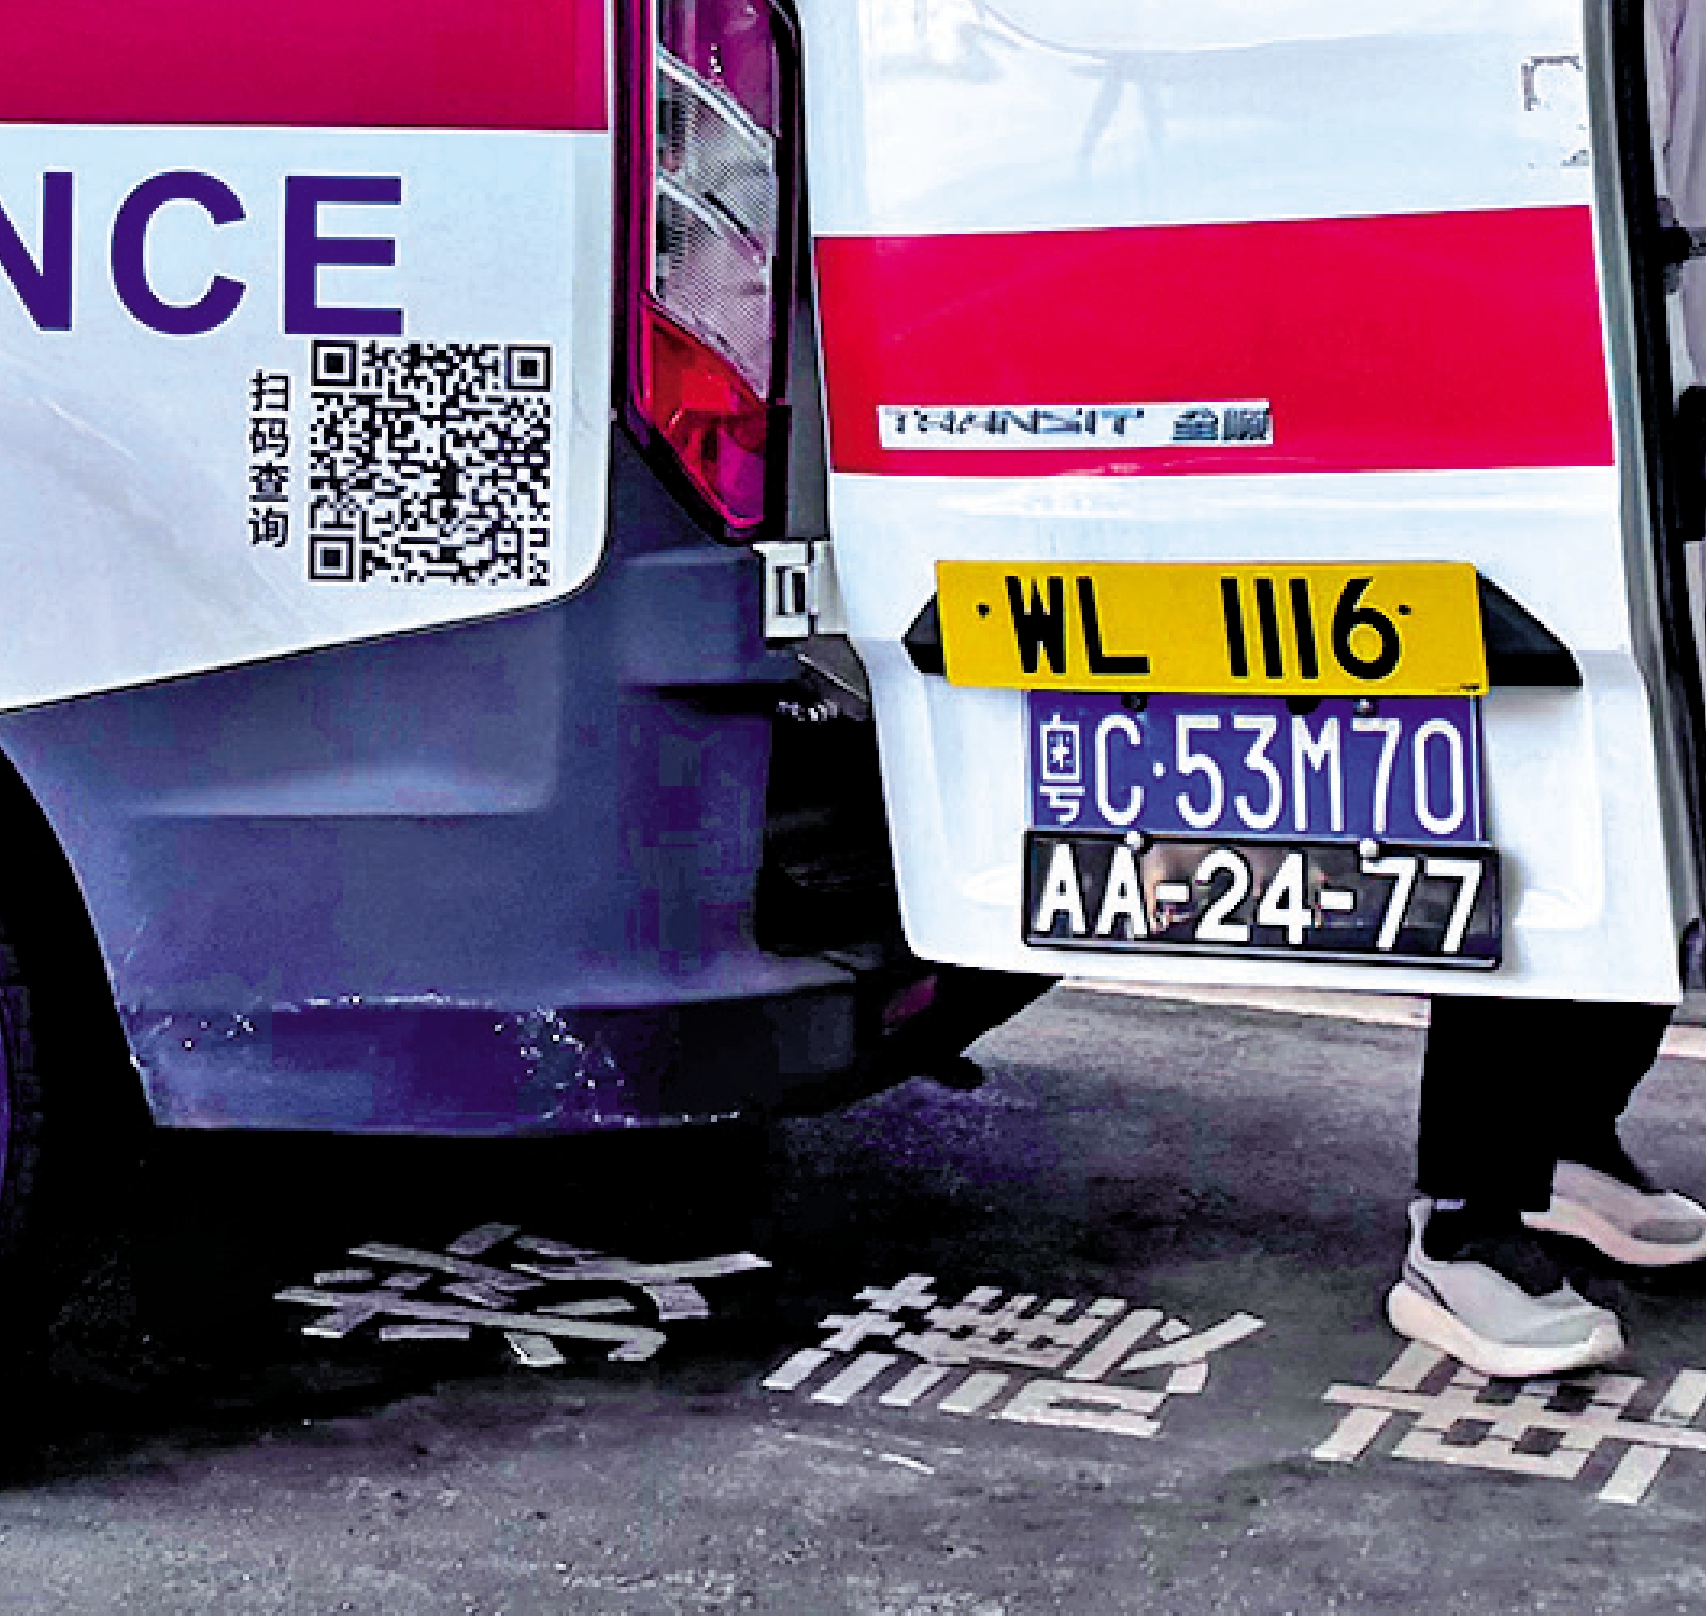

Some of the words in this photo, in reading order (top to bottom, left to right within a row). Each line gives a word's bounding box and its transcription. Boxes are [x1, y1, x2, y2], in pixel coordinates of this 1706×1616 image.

[248, 368, 289, 549] 扫码查询
[1005, 575, 1150, 675] WL
[1220, 575, 1402, 680] 1116
[1032, 842, 1484, 953] AA-24-77
